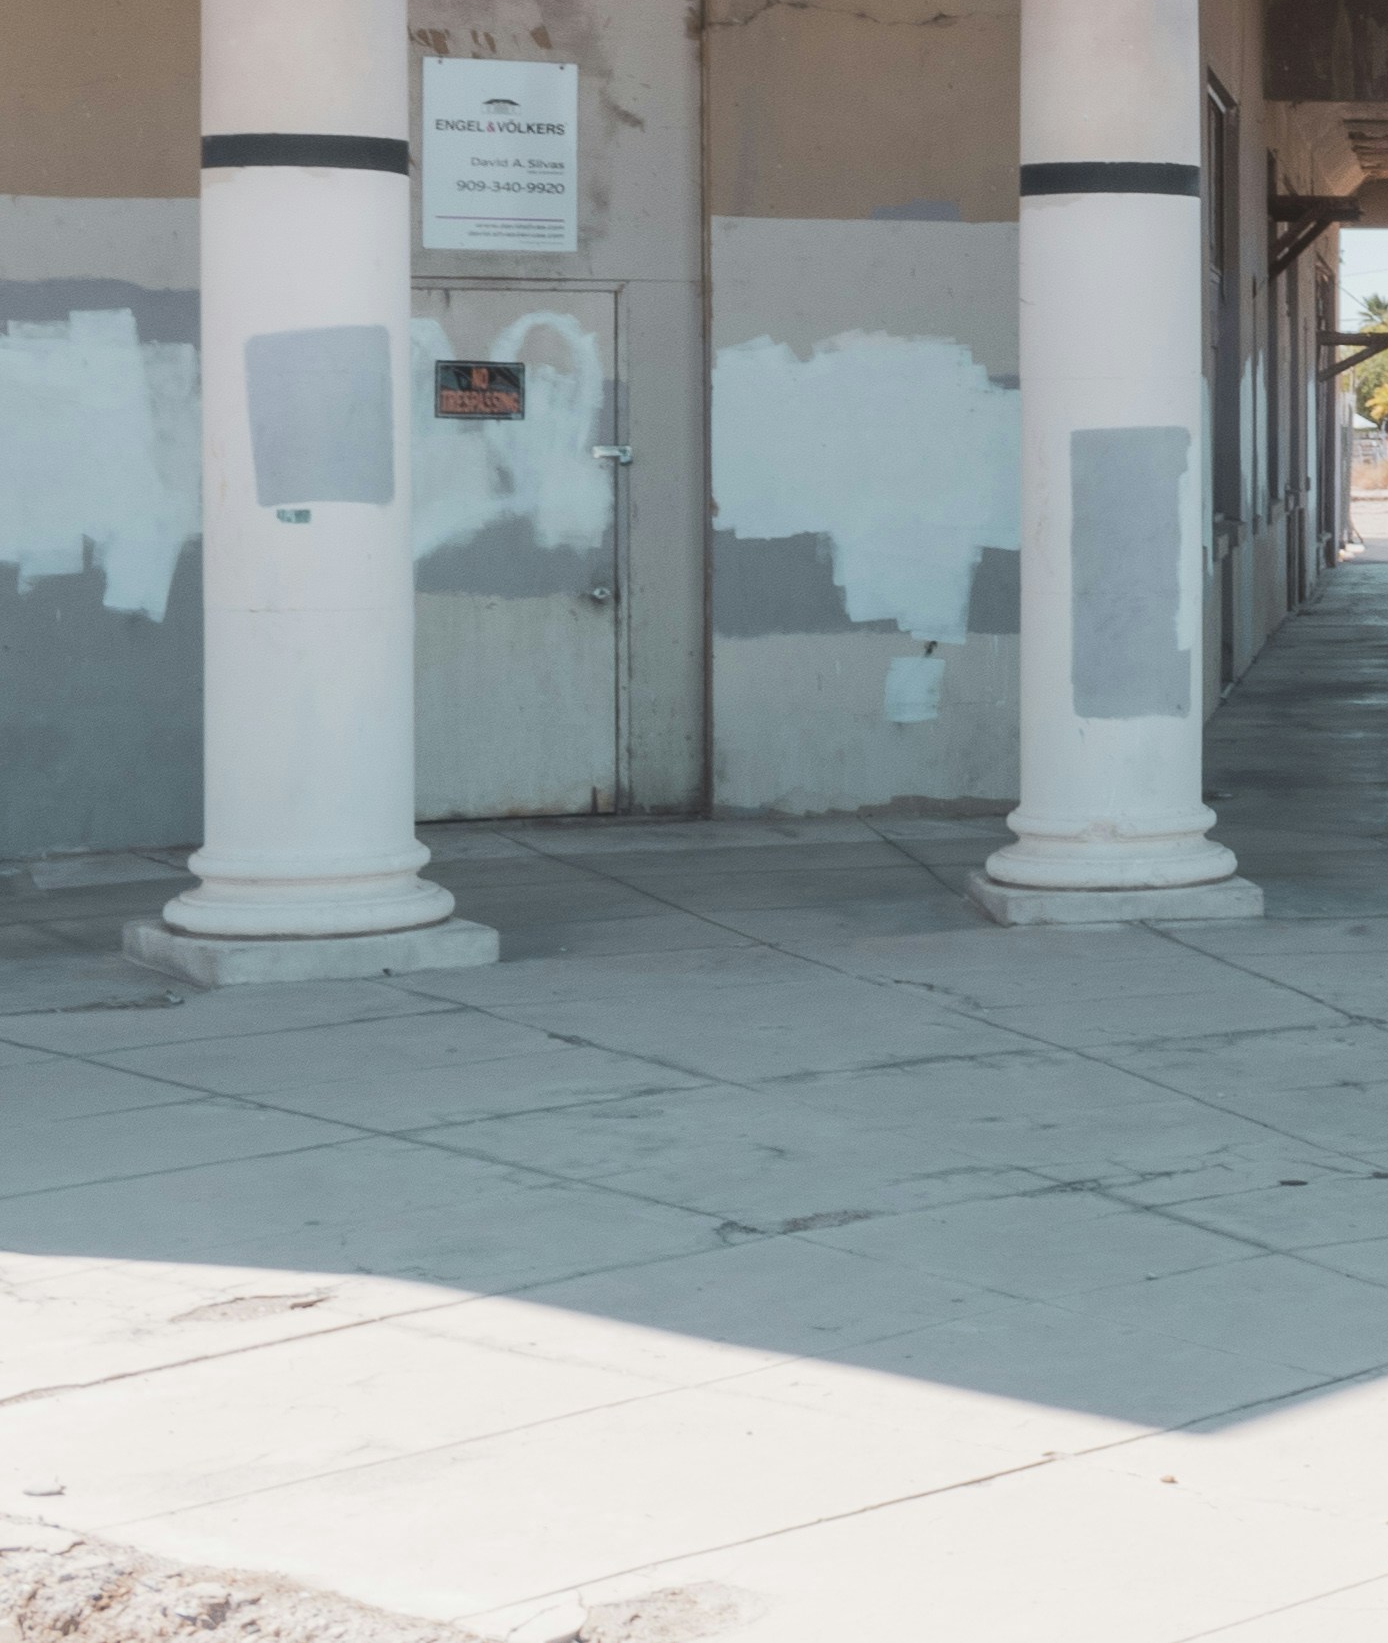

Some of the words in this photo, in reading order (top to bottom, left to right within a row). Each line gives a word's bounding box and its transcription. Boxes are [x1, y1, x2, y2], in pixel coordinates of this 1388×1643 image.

[471, 157, 508, 167] David
[528, 159, 565, 169] Silvas
[456, 180, 565, 194] 909-340-9920
[472, 367, 489, 389] NO
